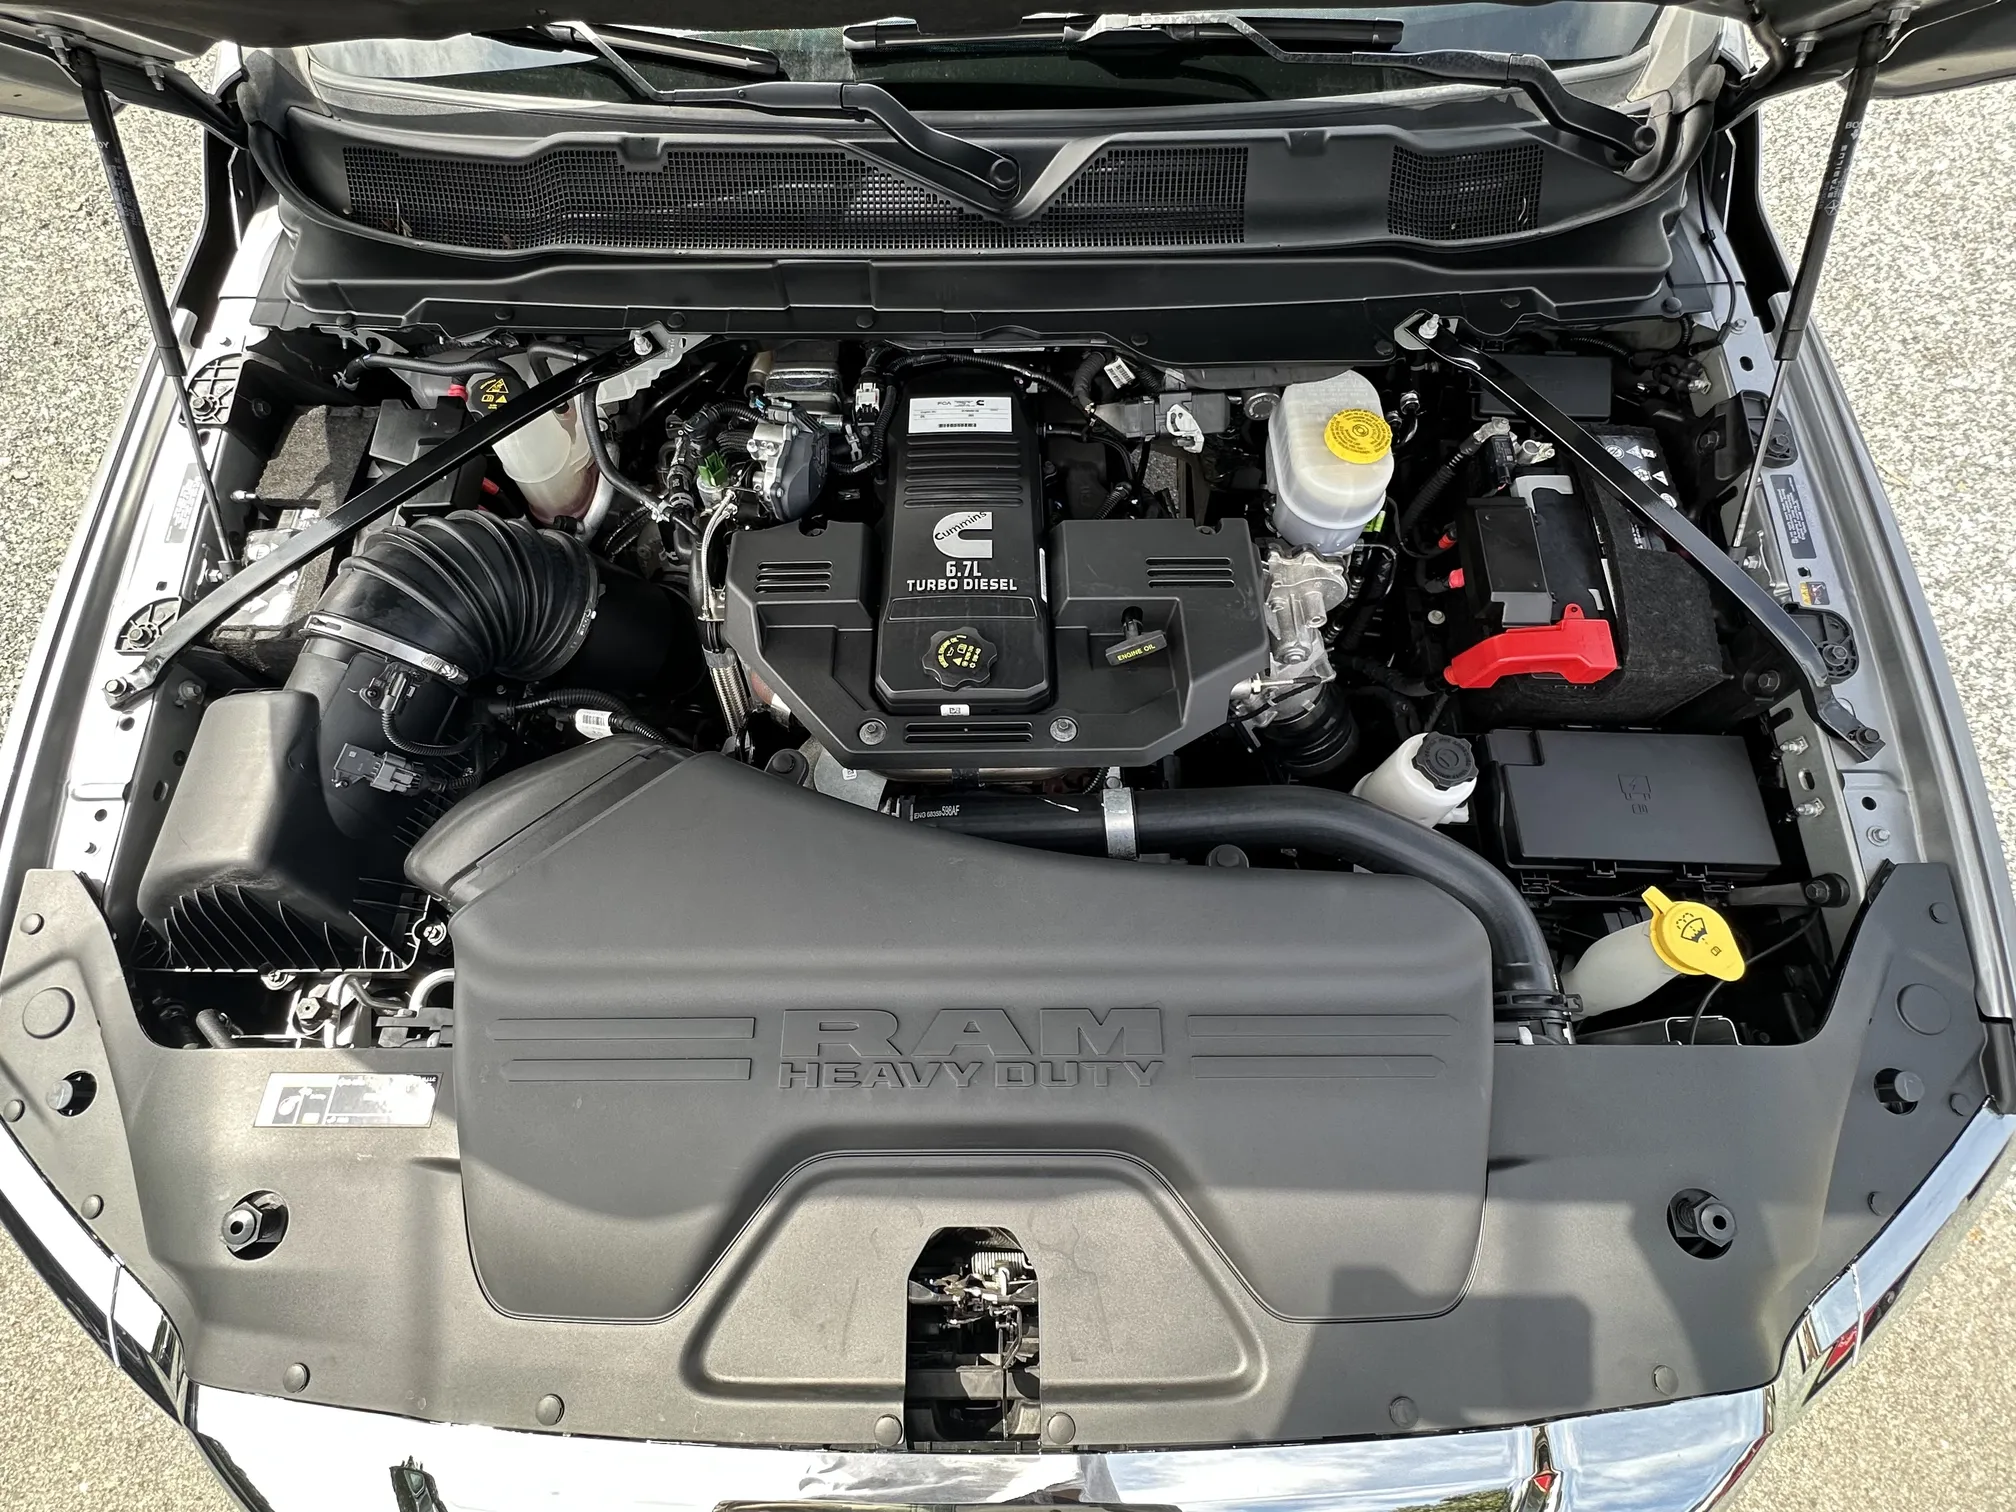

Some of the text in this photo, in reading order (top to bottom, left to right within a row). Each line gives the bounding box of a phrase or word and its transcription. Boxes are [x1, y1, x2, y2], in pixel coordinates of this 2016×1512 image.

[1827, 145, 1848, 198] STABILUS
[934, 511, 987, 541] Cummins
[946, 560, 982, 577] 6.7L
[906, 578, 1018, 592] TURBO DIESEL
[1117, 643, 1156, 661] ENGINE OIL
[781, 1007, 1164, 1057] RAM
[778, 1060, 1165, 1088] HEAVY DUTY
